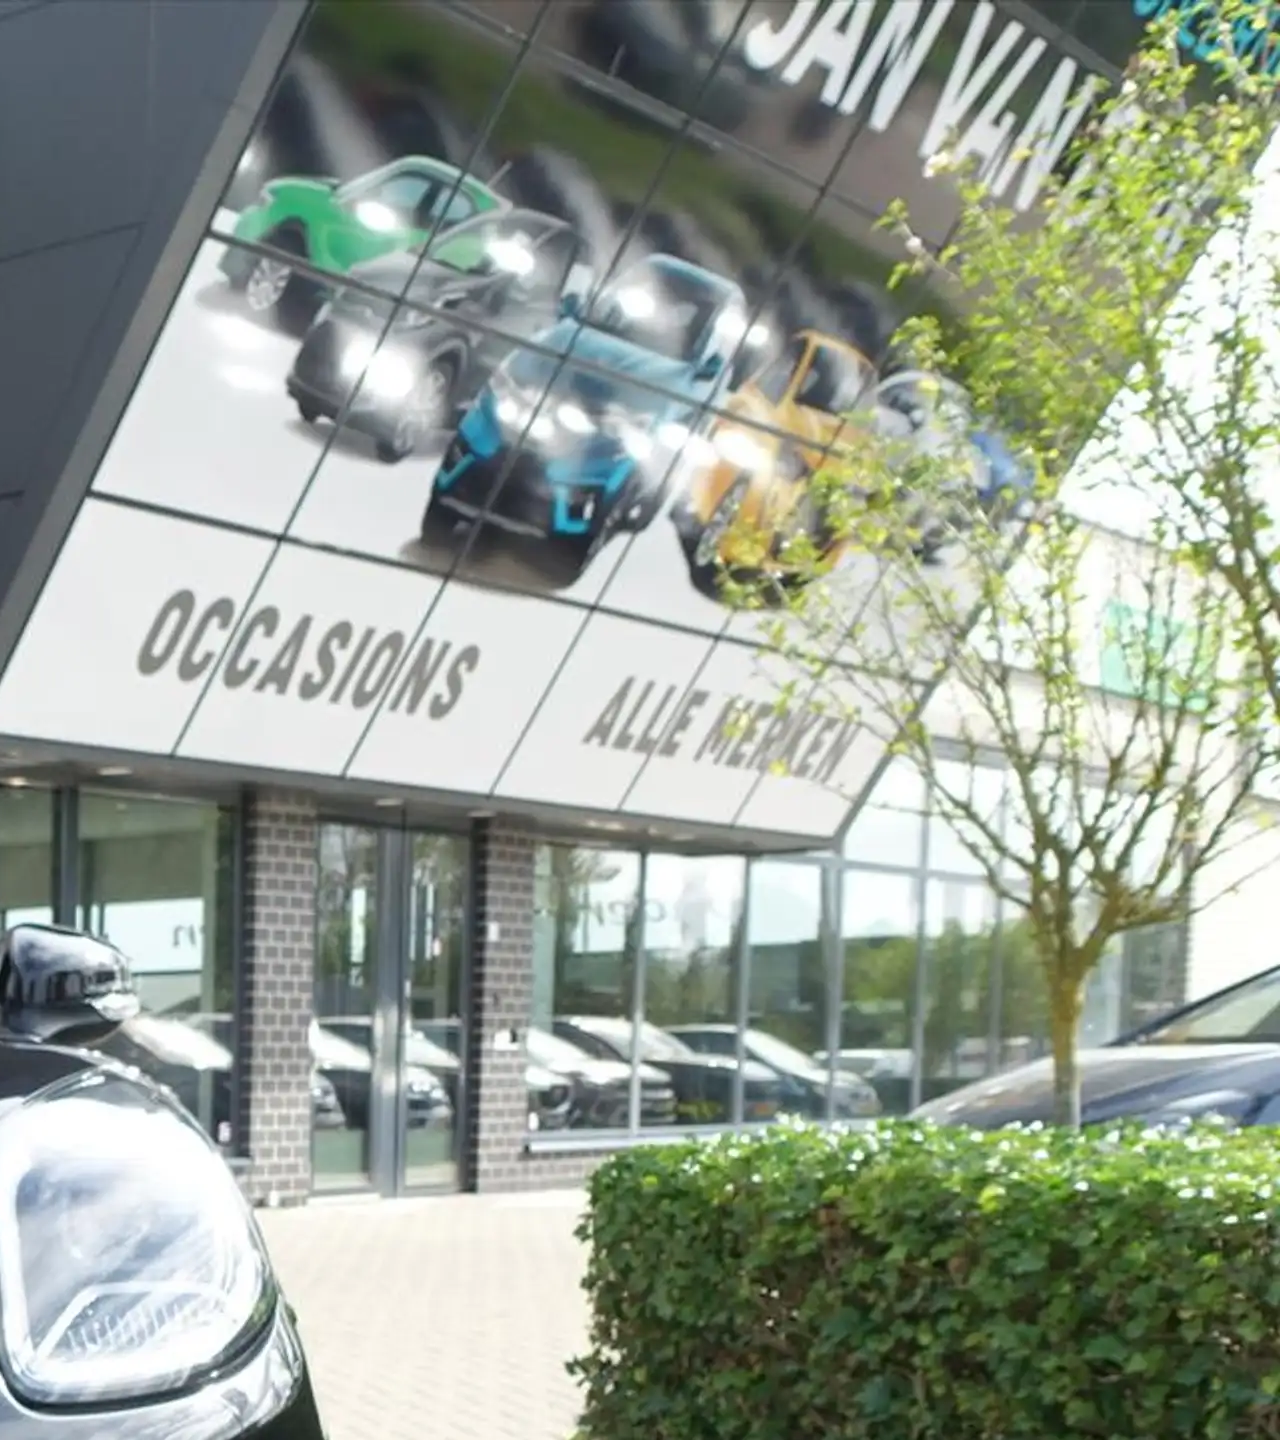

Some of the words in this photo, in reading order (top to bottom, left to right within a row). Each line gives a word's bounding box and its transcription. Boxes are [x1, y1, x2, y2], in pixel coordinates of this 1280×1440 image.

[136, 589, 481, 720] OCCASIONS
[582, 675, 710, 757] ALLE
[692, 695, 861, 785] MERKEN
